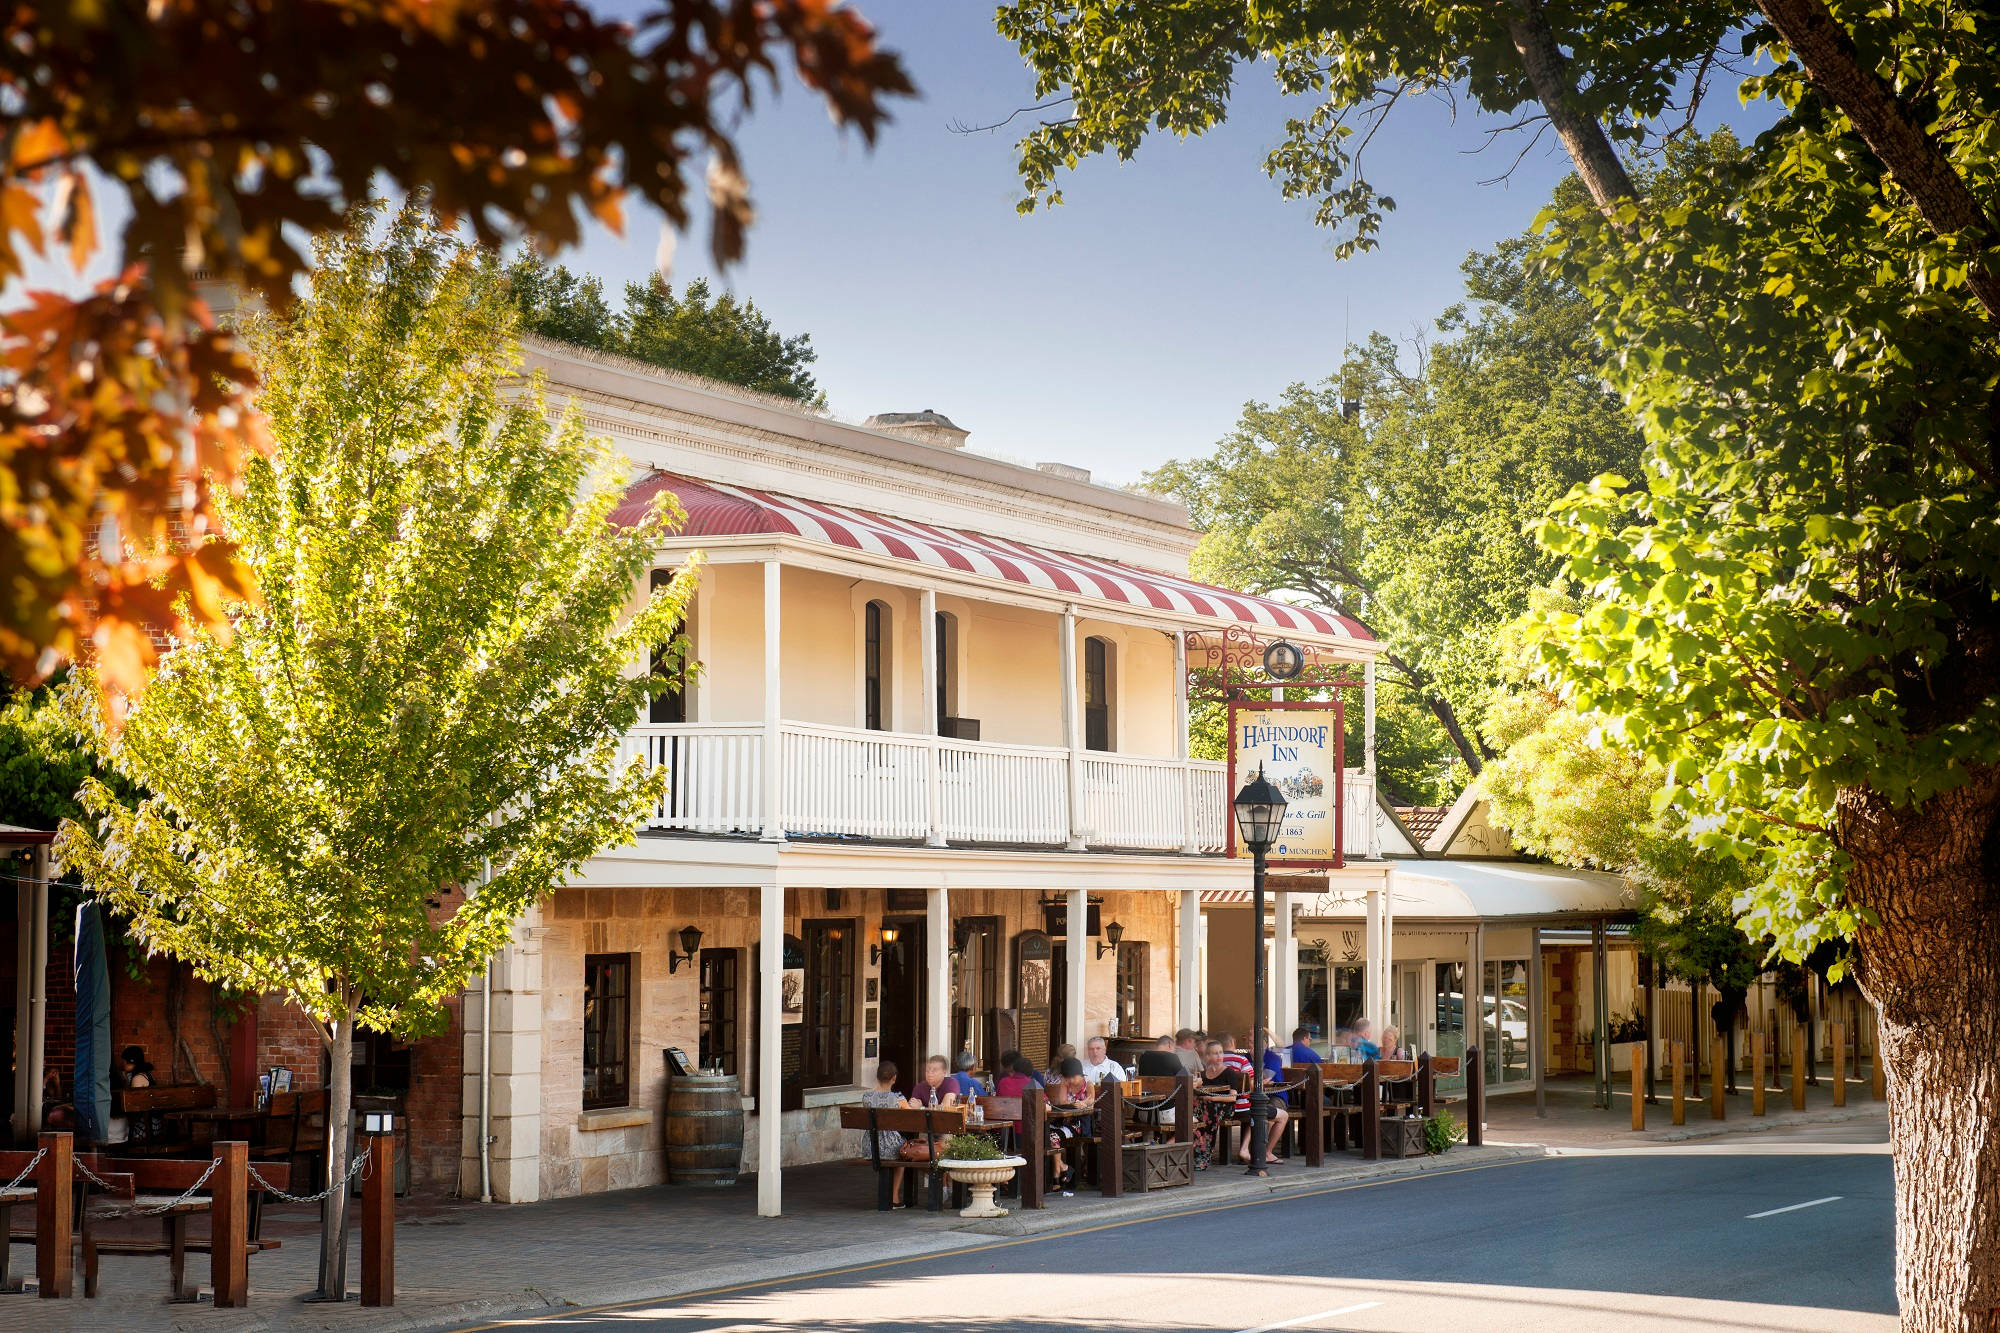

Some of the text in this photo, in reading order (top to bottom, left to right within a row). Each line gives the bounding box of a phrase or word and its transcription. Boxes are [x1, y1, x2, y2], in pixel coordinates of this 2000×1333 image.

[1254, 714, 1271, 725] The
[1243, 726, 1328, 748] HAHNDORF
[1272, 744, 1298, 761] INN
[1307, 810, 1326, 818] Grill
